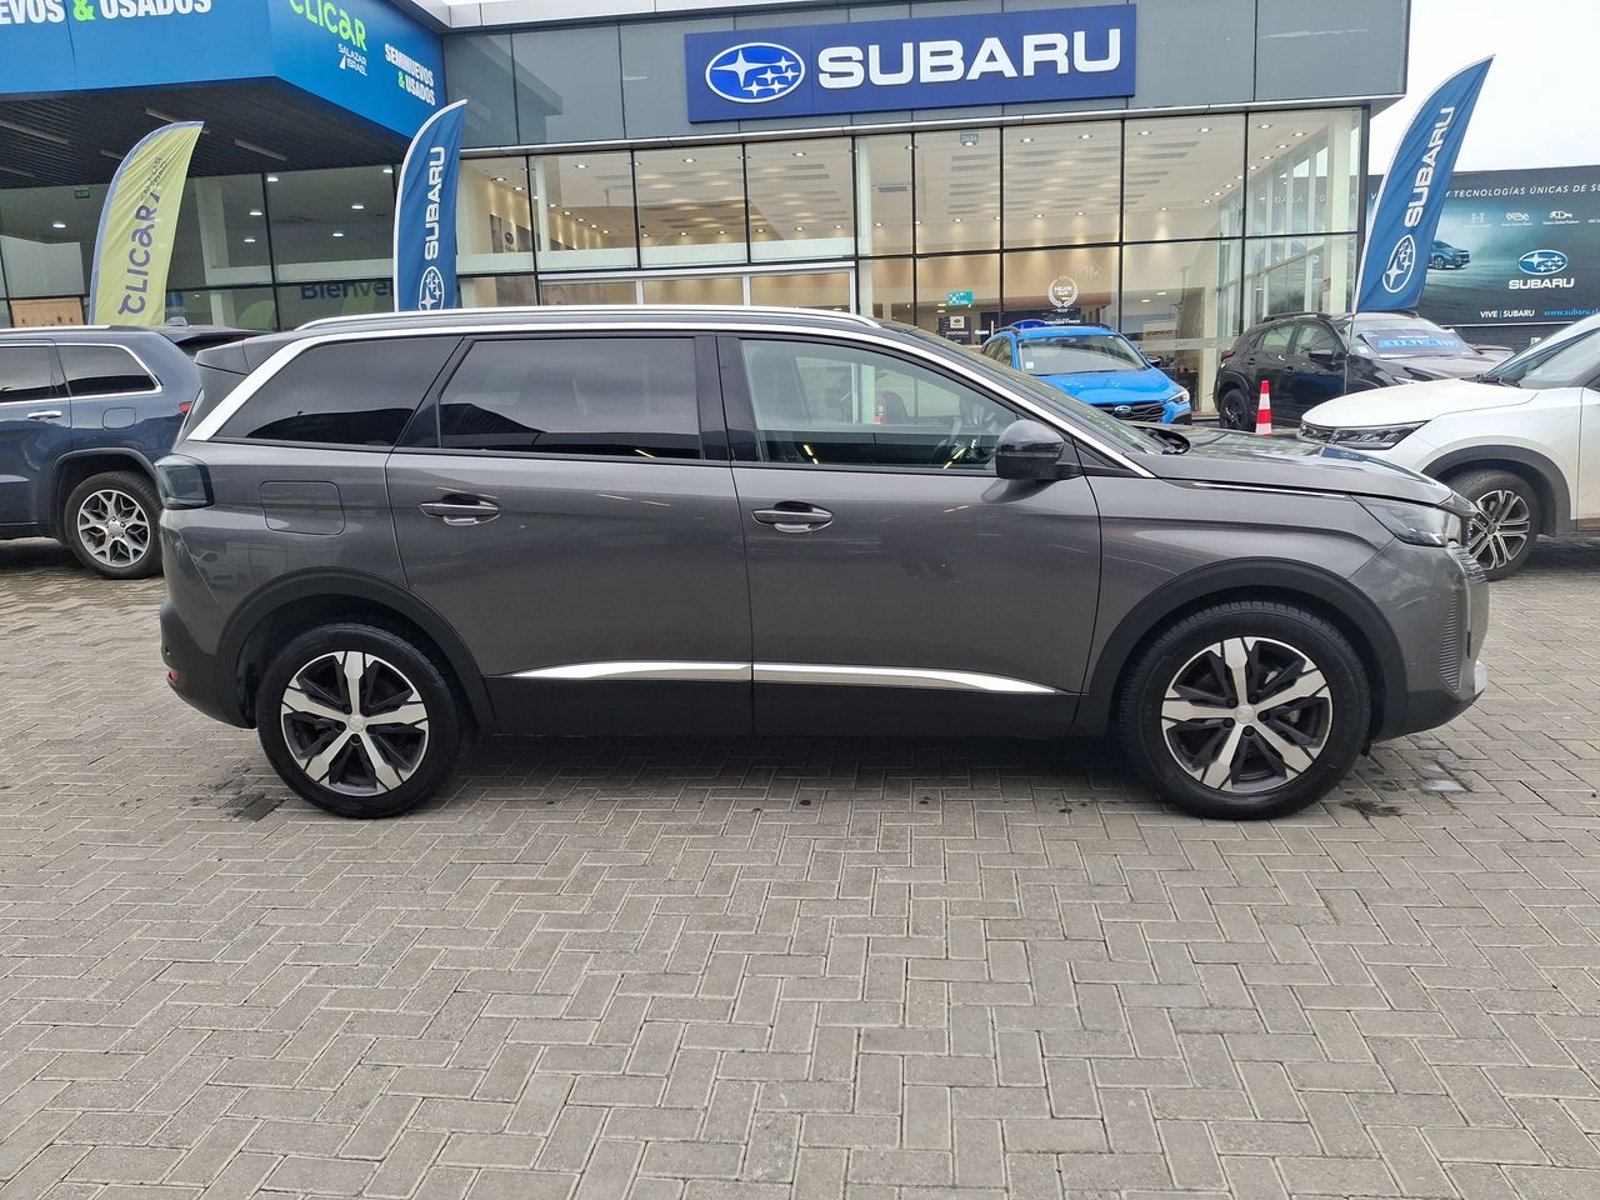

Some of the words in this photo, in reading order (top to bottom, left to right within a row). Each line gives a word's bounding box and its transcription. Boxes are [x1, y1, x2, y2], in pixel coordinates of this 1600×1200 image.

[73, 0, 96, 21] &
[100, 0, 212, 20] USADOS
[384, 43, 434, 87] SEMINUEVOS
[817, 28, 1121, 90] SUBARU
[398, 70, 406, 90] &
[405, 74, 436, 106] USADOS
[1404, 106, 1456, 228] SUBARU
[424, 146, 446, 261] SUBARU
[1454, 186, 1527, 198] TECNOLOGÍAS
[1529, 184, 1569, 195] ÚNICAS
[1572, 183, 1587, 193] DE
[1508, 277, 1576, 290] SUBARU
[1480, 310, 1499, 319] VIVE
[1503, 309, 1536, 318] SUBARU
